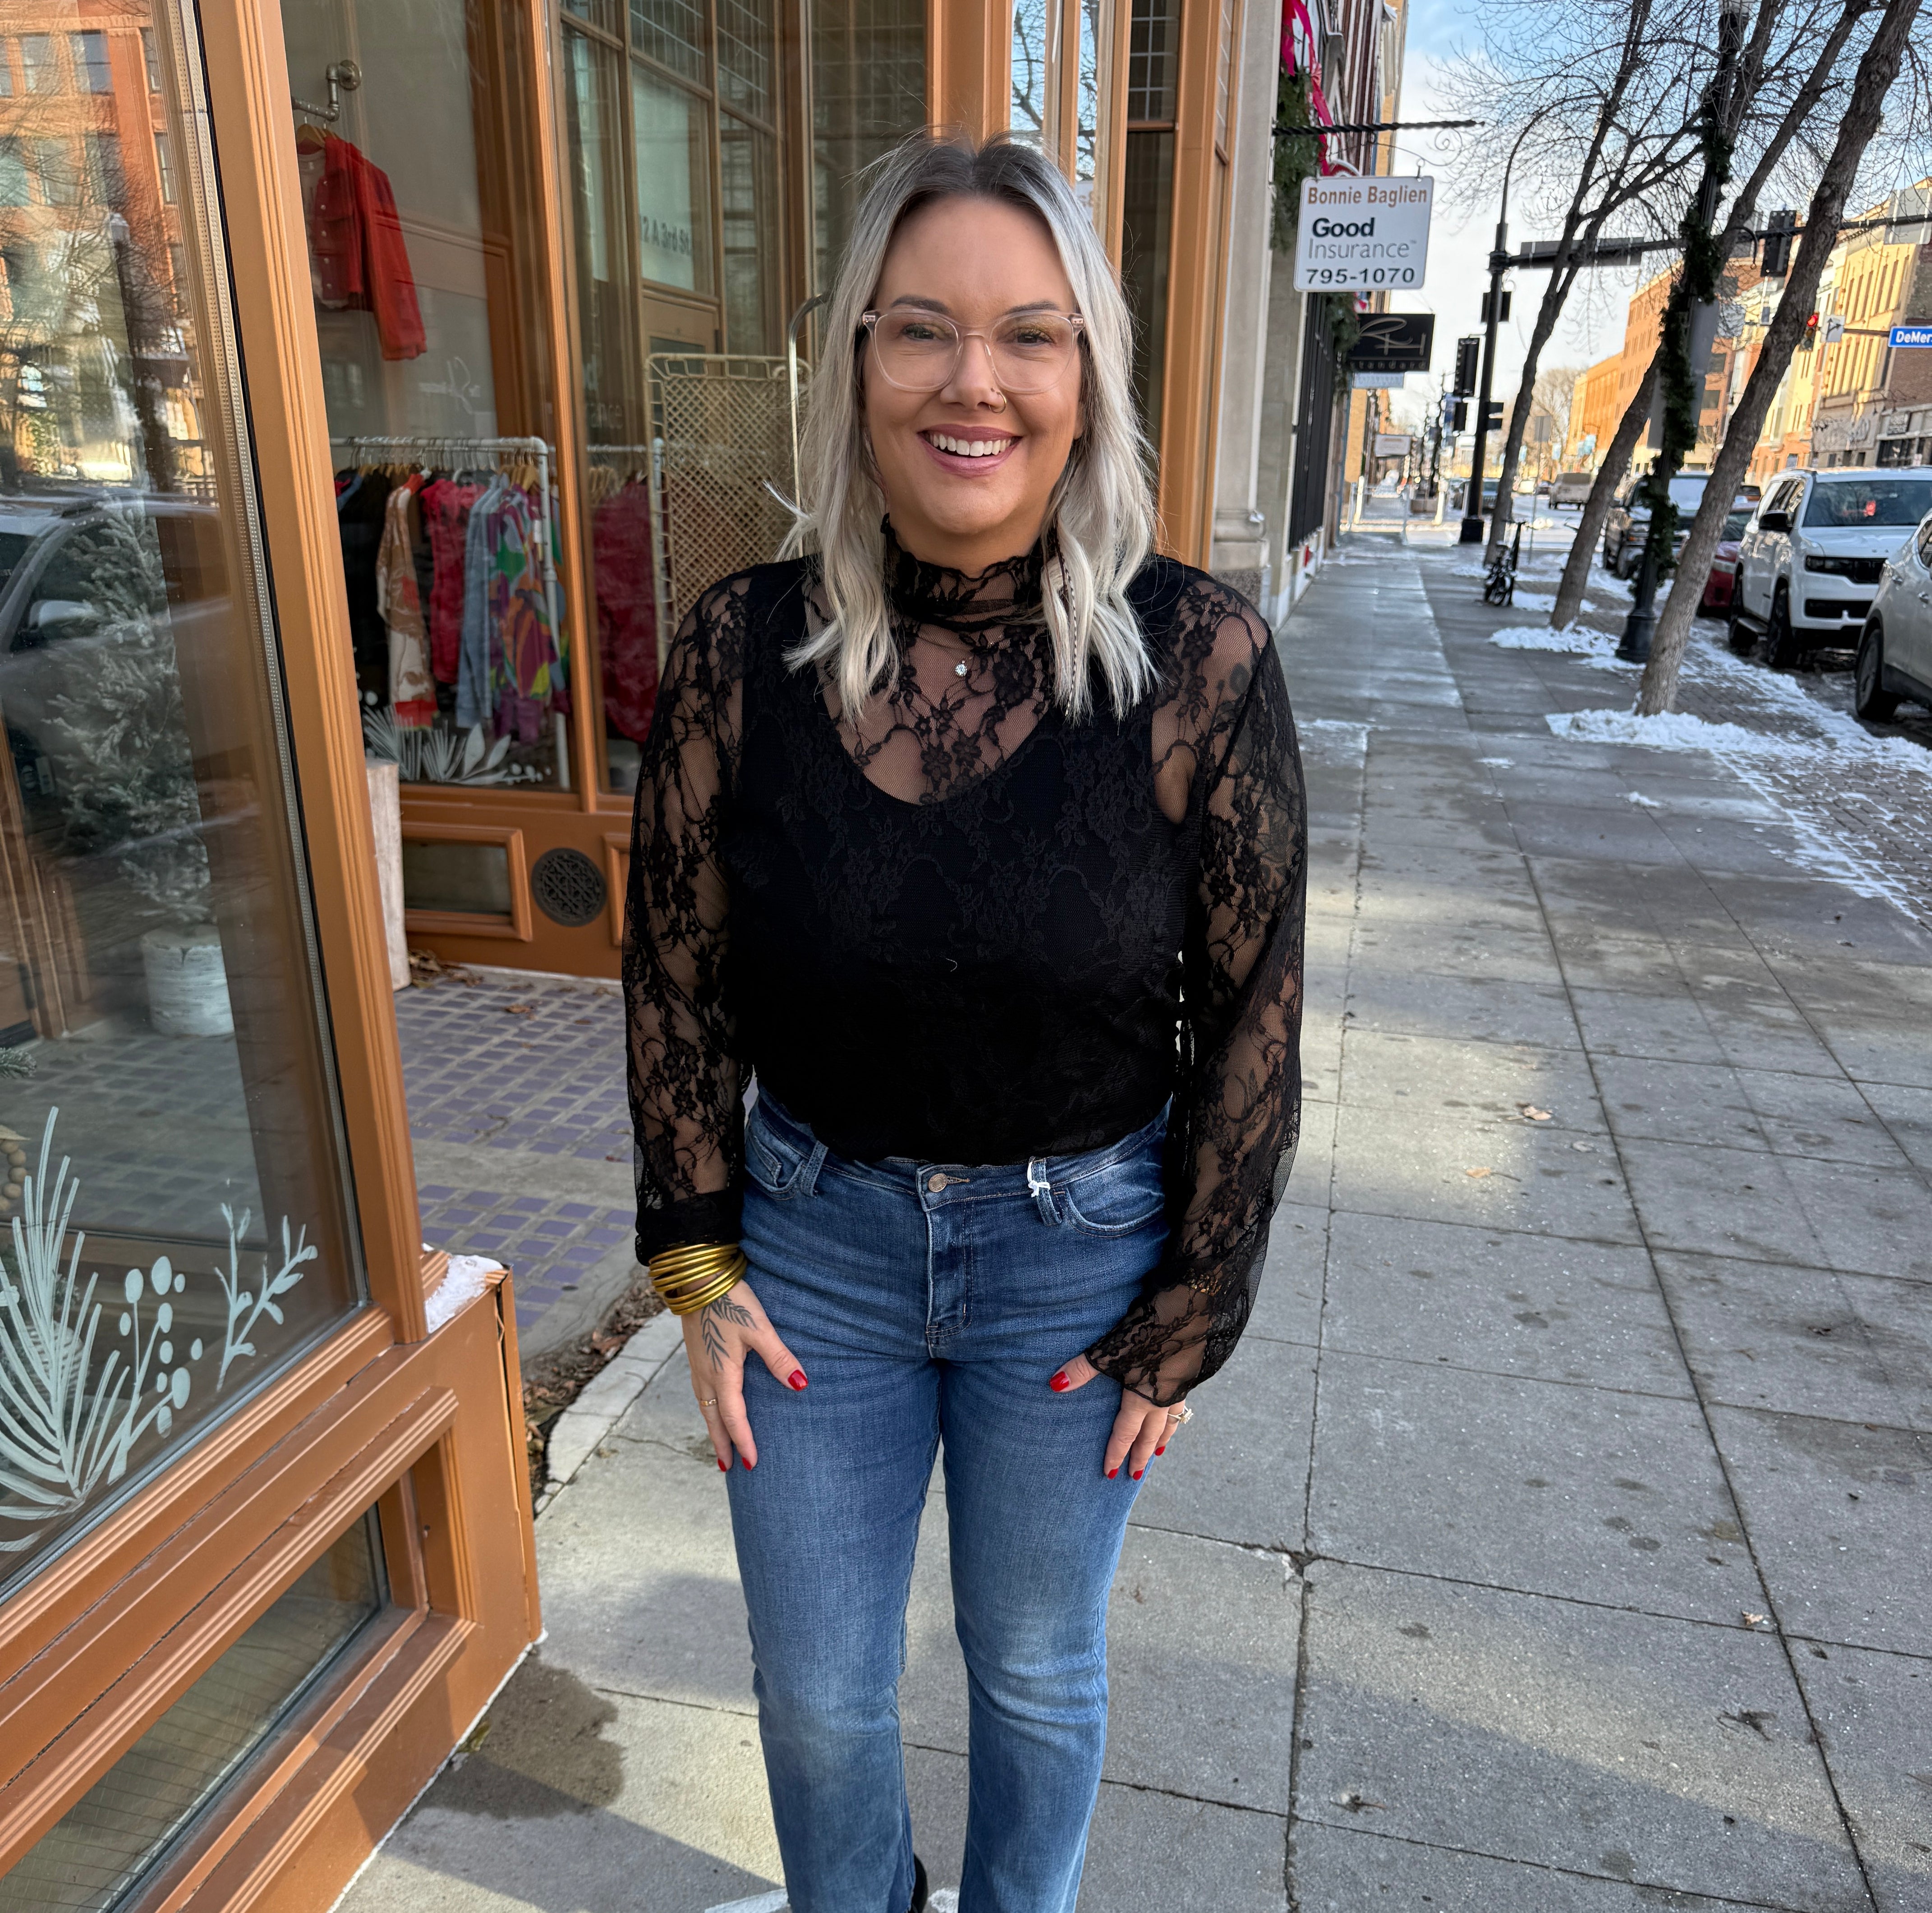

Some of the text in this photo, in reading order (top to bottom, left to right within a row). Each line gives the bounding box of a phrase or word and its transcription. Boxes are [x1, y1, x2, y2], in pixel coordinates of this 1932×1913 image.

[1308, 185, 1427, 208] Bonnie Baglien
[1312, 217, 1375, 238] Good
[1308, 238, 1410, 259] Insurance
[1306, 267, 1415, 284] 795-1070
[1895, 331, 1932, 343] DeMer
